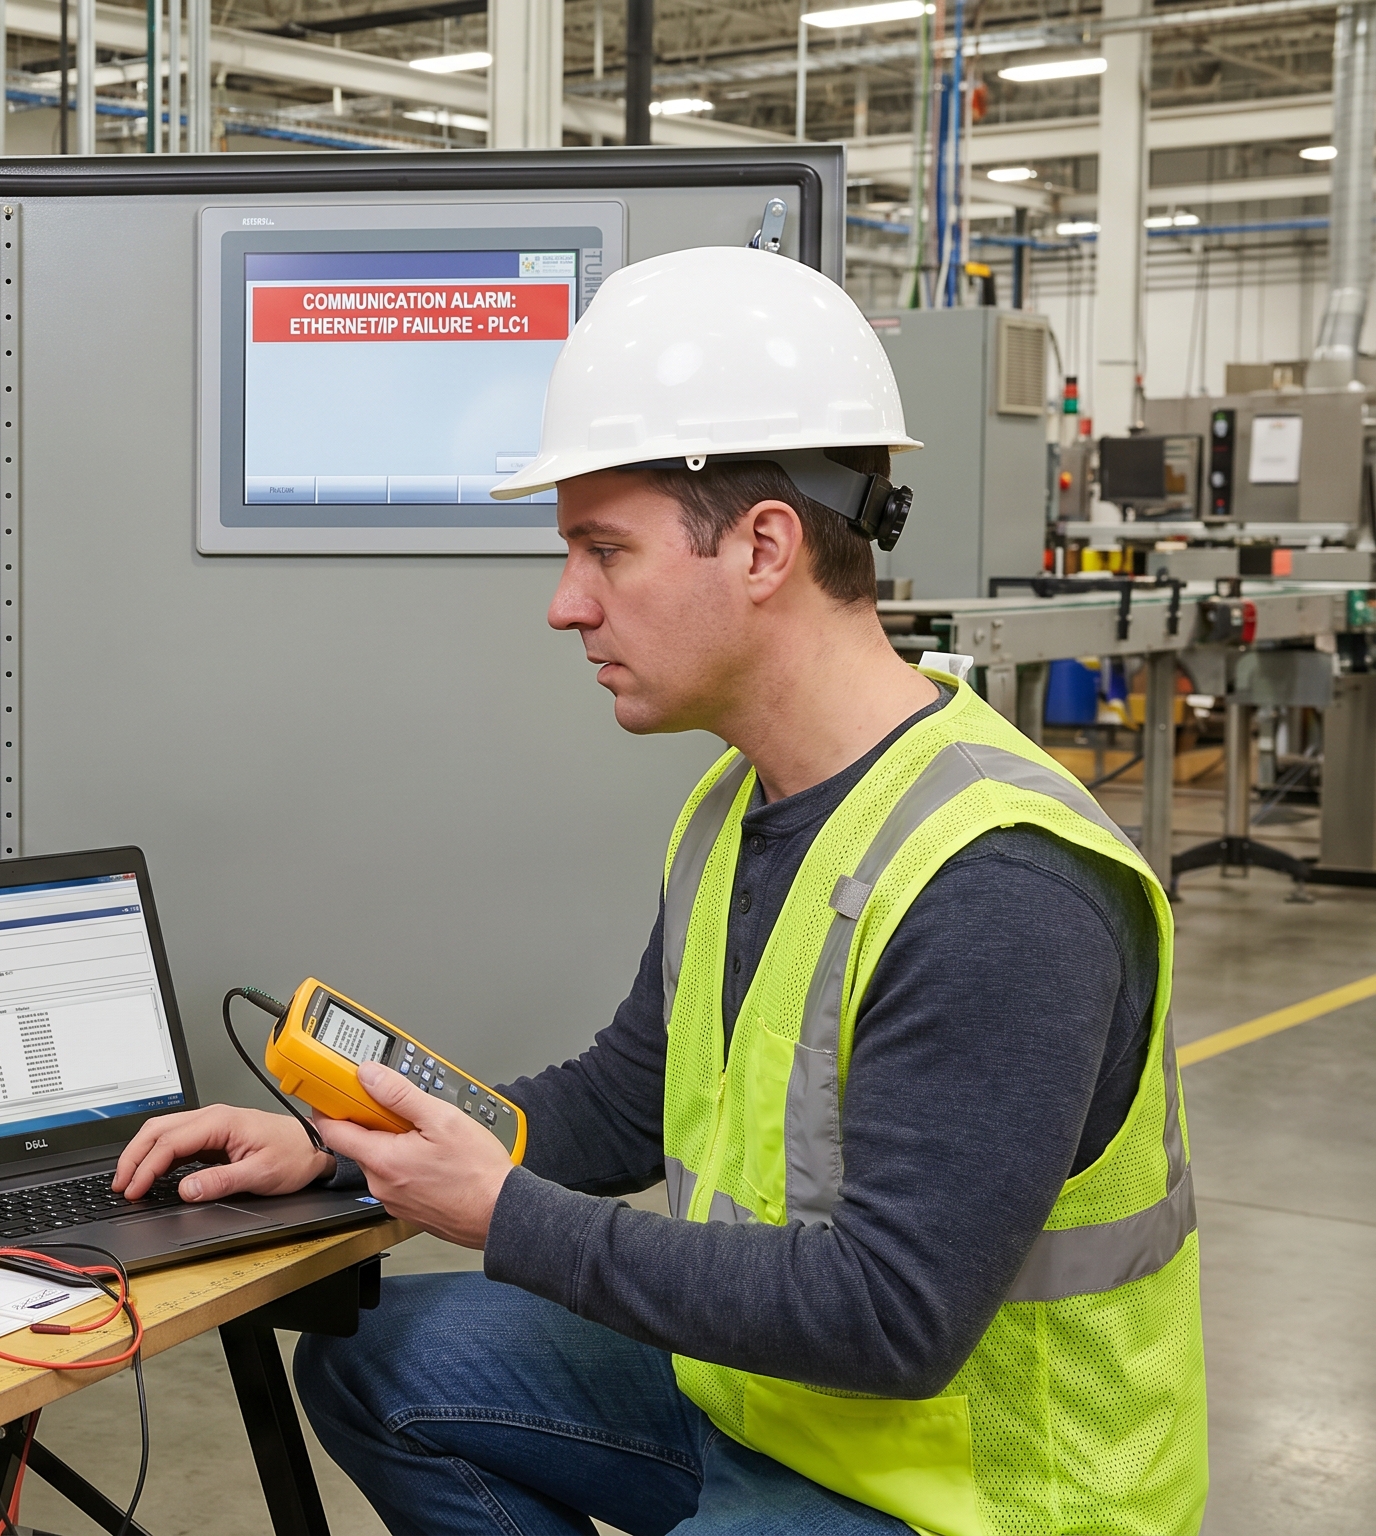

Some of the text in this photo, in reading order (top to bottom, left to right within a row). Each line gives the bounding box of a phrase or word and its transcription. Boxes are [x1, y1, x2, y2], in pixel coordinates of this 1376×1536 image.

[302, 291, 517, 310] COMMUNICATION ALARM:
[290, 316, 399, 335] ETHERNET/IP
[402, 316, 473, 334] FAILURE
[488, 315, 529, 333] PLC1
